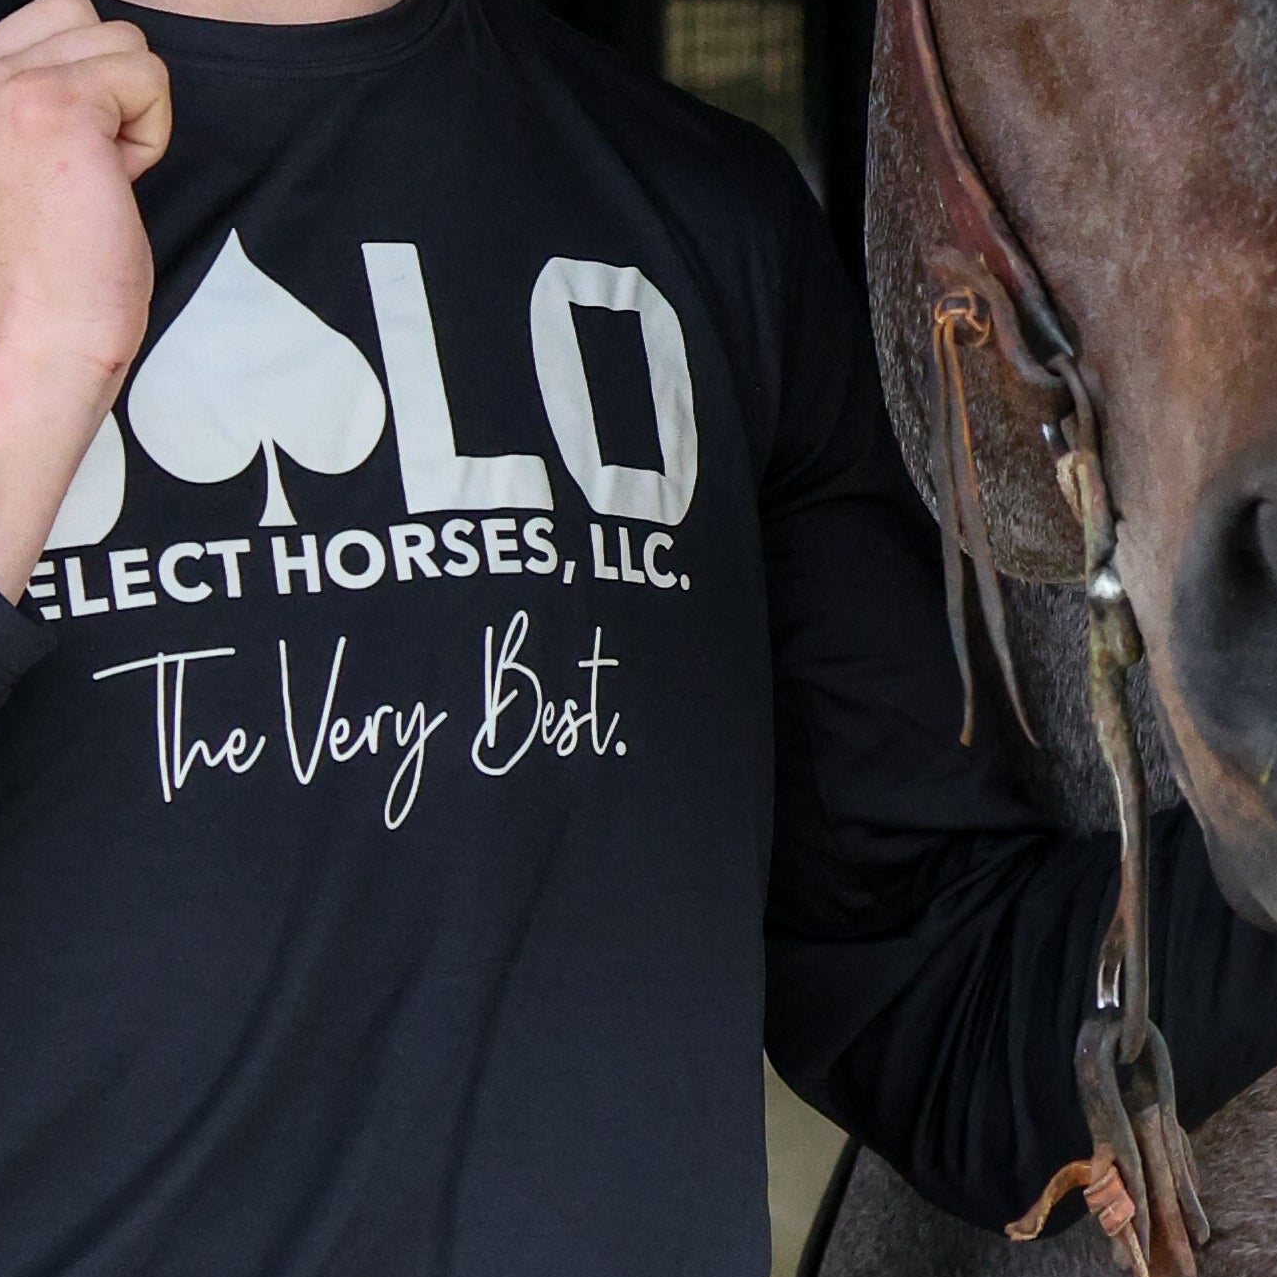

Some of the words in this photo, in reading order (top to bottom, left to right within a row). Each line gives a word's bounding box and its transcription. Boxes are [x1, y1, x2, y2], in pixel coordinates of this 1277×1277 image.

[26, 537, 252, 622] ELECT
[271, 517, 577, 598] HORSES,
[589, 522, 692, 592] LLC.
[92, 646, 267, 804] The
[278, 634, 448, 831] Very
[471, 609, 628, 776] Best.
